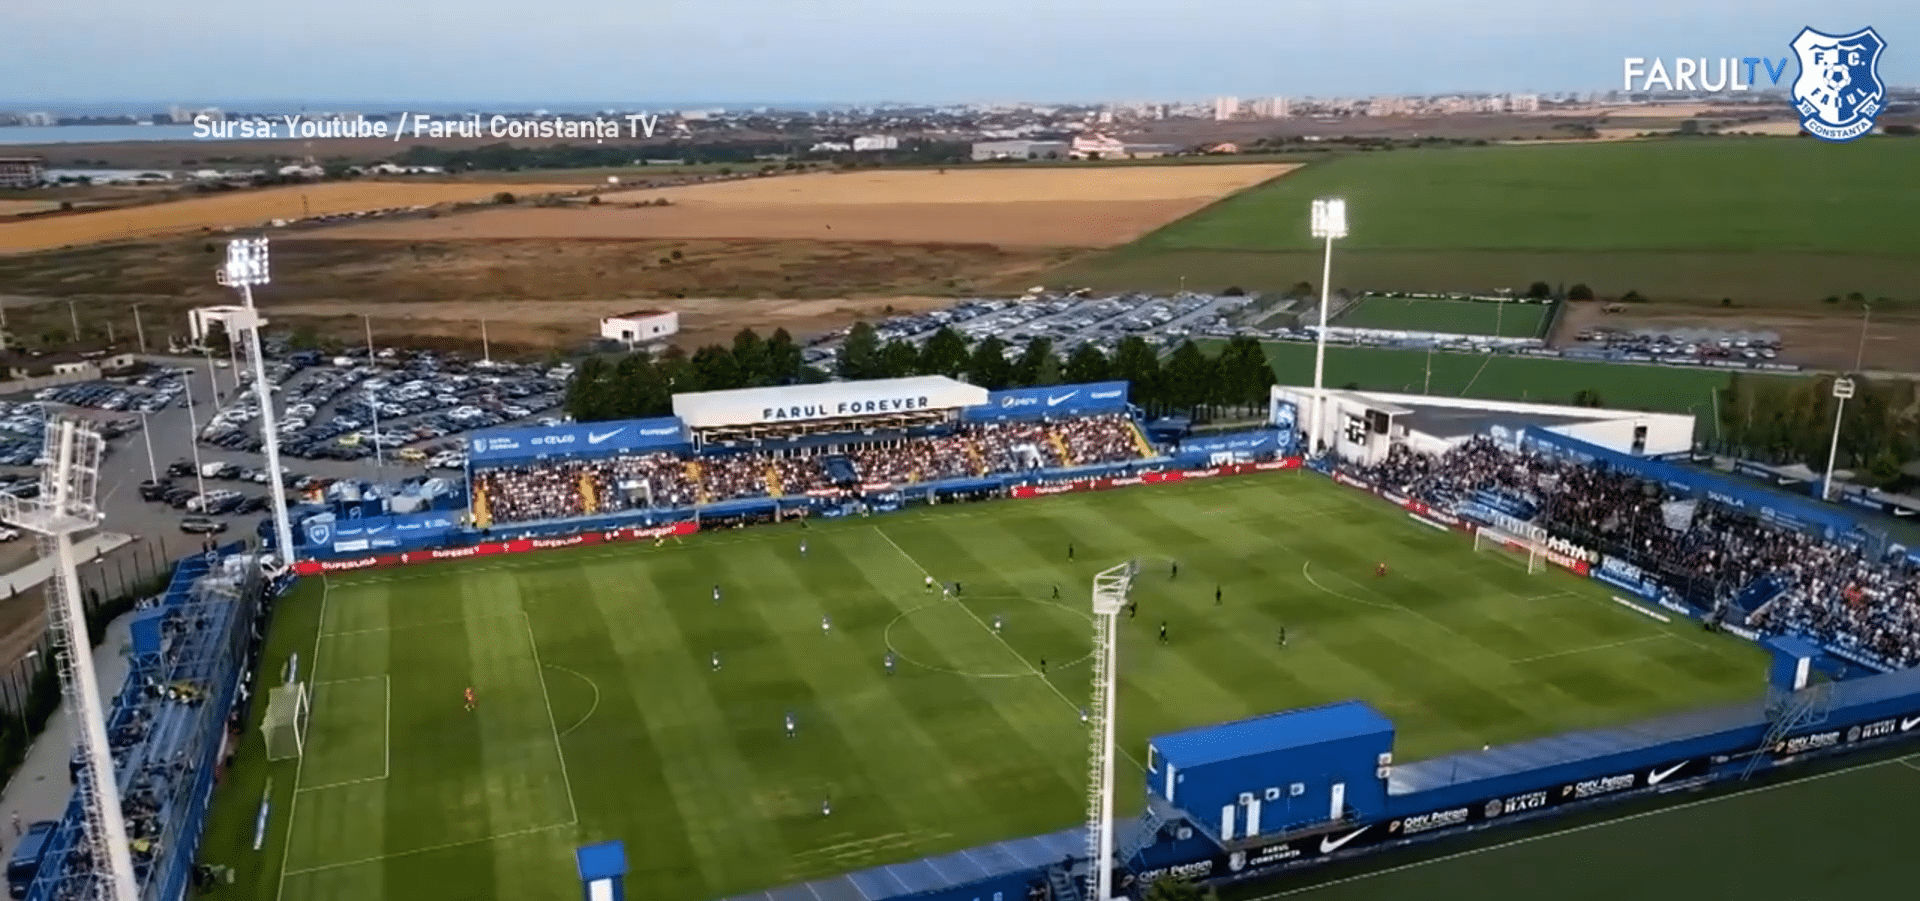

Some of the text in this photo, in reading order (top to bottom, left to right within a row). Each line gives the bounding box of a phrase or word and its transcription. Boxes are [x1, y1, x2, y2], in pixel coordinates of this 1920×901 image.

[762, 395, 929, 420] FARUL FOREVER
[321, 557, 377, 570] SUPERLIGA
[1504, 795, 1547, 813] HAGI
[1403, 816, 1430, 829] OMV
[1431, 807, 1469, 824] Petrom
